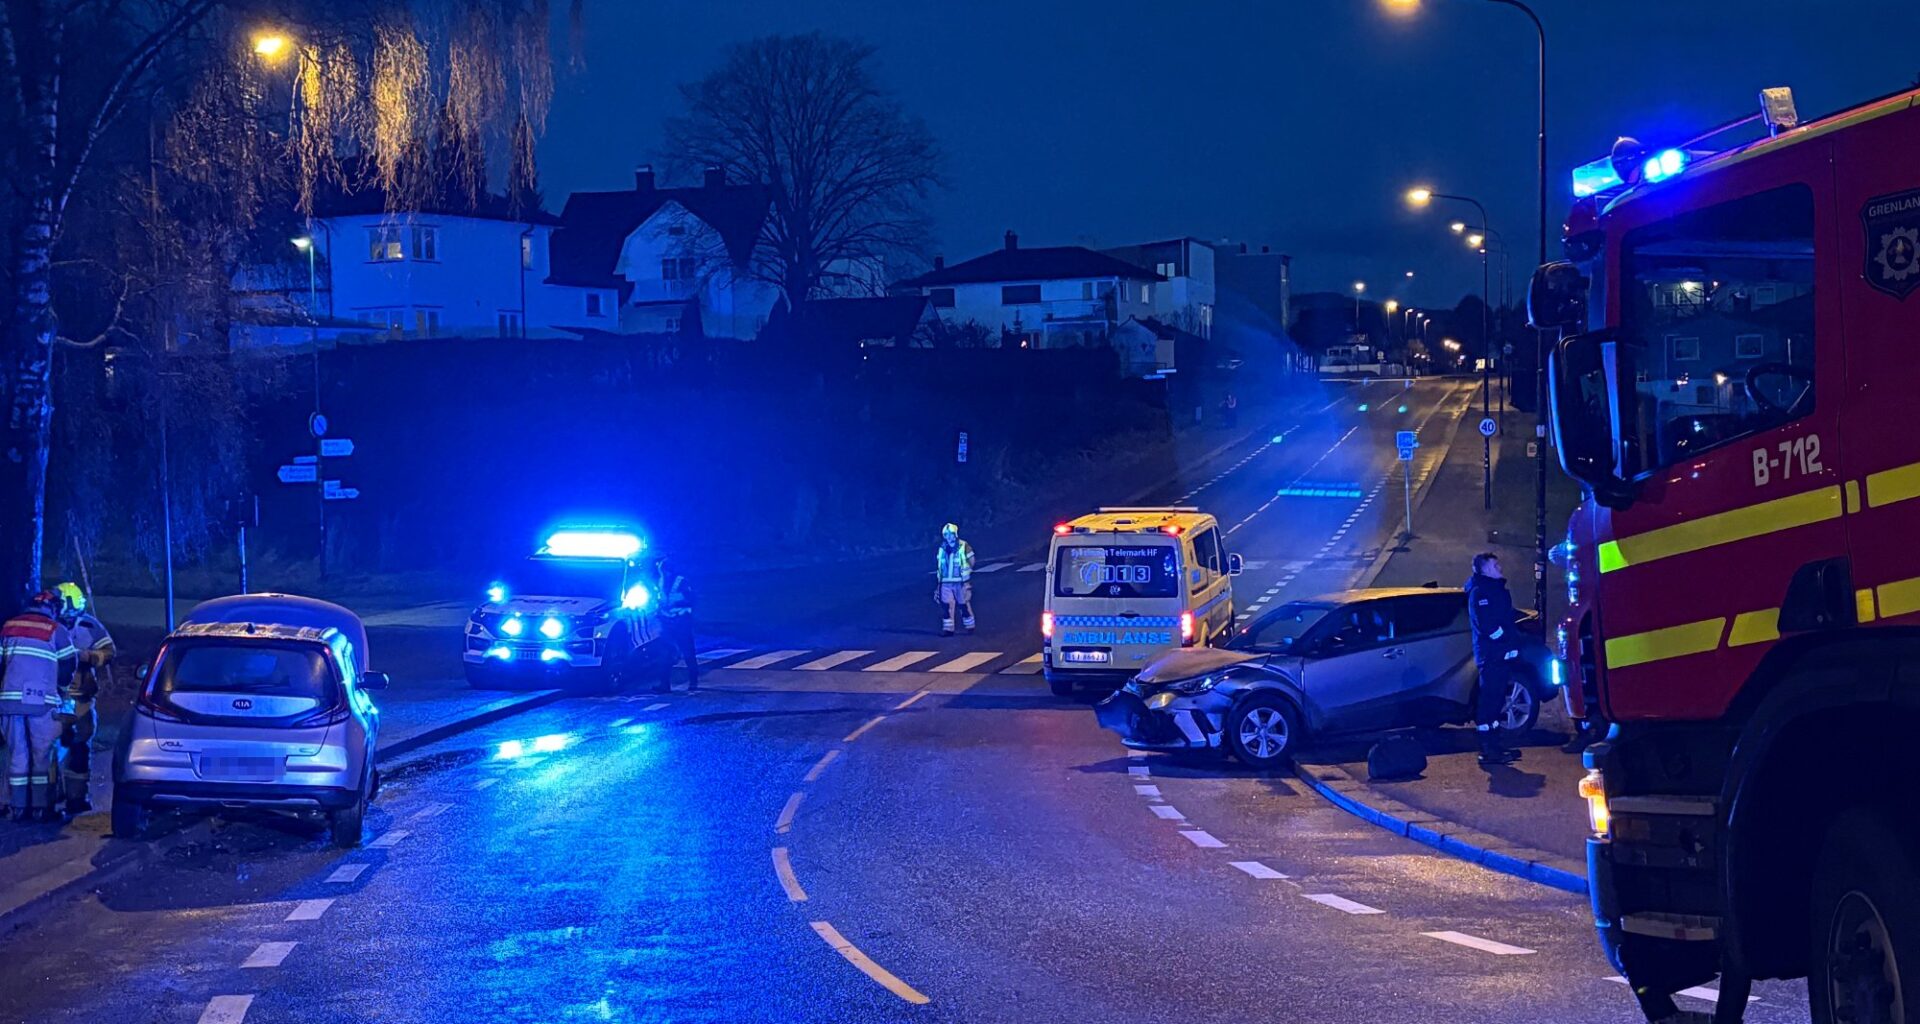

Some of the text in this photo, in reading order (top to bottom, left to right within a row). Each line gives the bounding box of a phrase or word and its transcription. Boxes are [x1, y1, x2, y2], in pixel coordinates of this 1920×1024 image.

[1481, 421, 1494, 432] 40
[1752, 434, 1823, 487] B-712
[1109, 549, 1146, 557] Telemark
[235, 700, 250, 708] KIA
